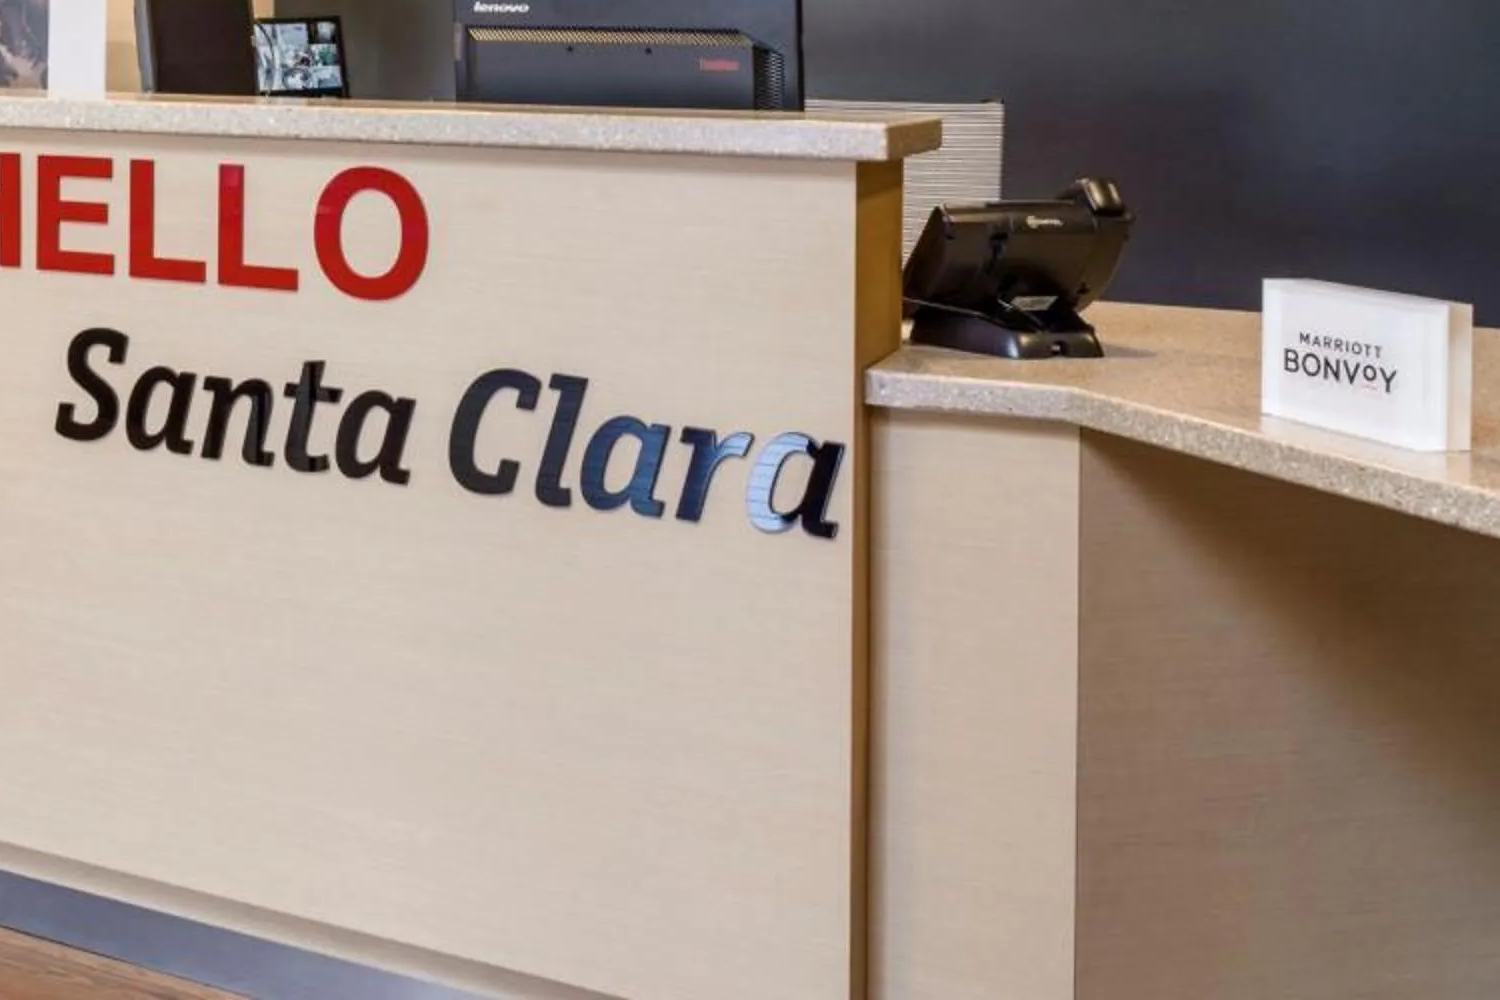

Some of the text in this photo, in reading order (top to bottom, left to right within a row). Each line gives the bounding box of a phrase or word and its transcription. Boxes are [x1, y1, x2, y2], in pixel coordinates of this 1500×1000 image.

[473, 0, 530, 13] lenovo
[1299, 332, 1382, 359] MARRIOTT
[1283, 348, 1397, 394] BONVOY
[54, 327, 846, 539] Santa Clara
